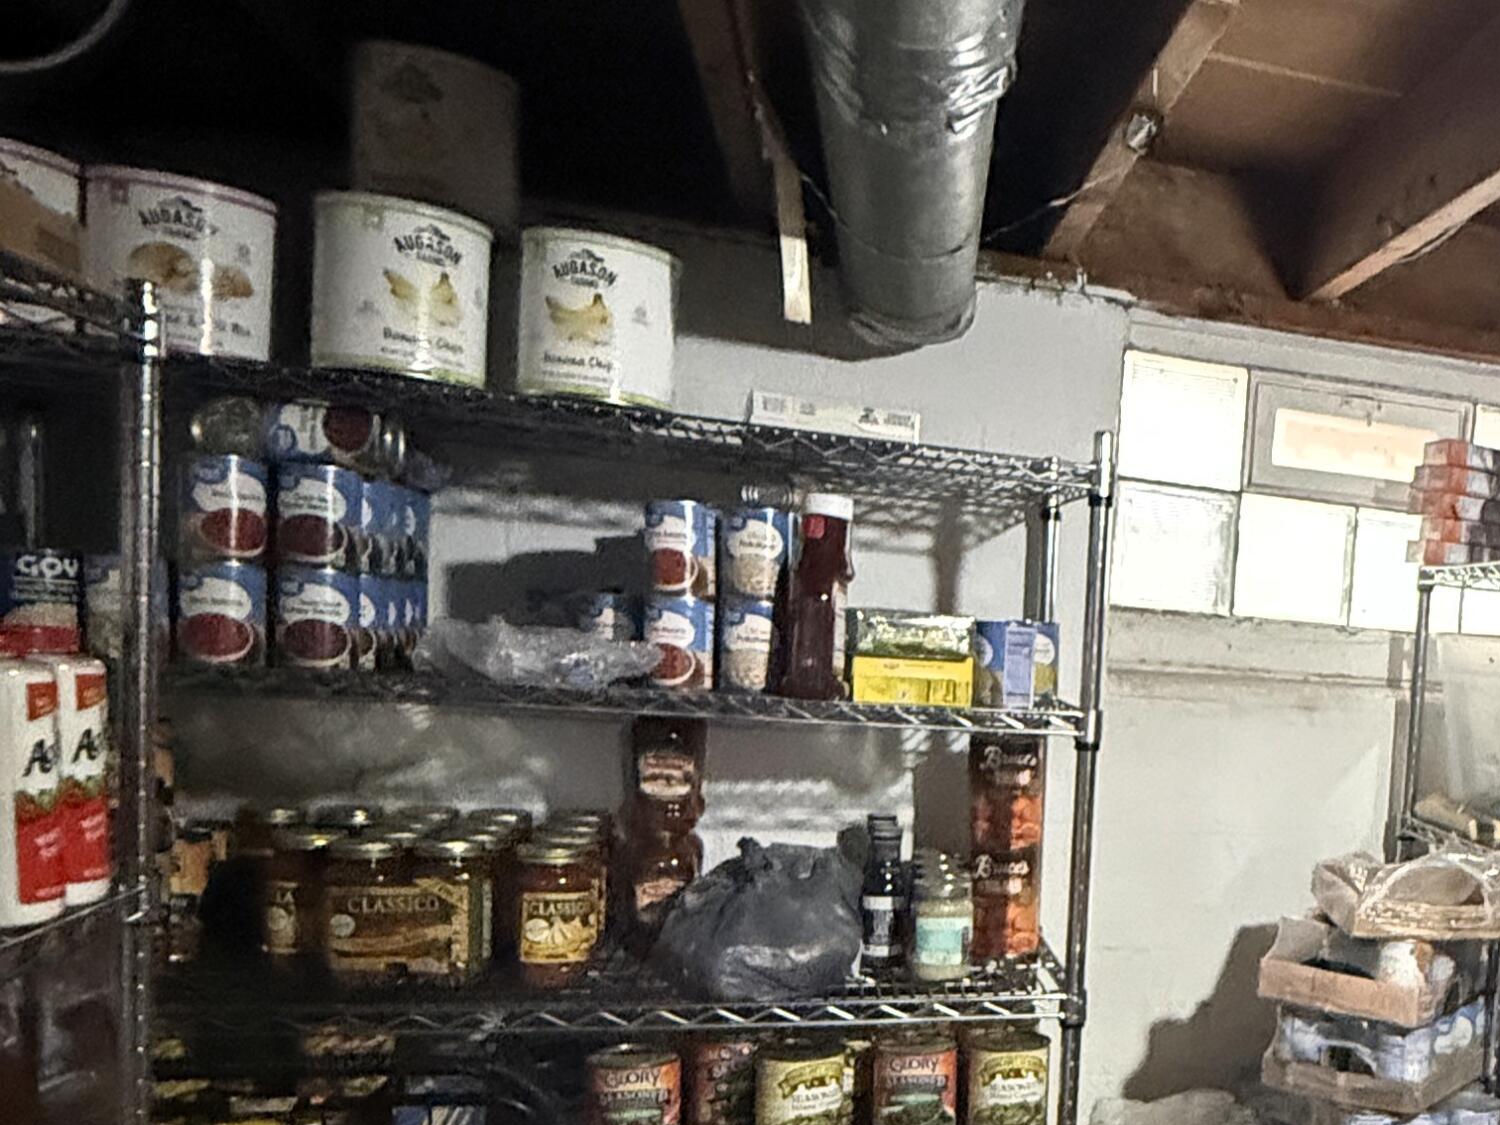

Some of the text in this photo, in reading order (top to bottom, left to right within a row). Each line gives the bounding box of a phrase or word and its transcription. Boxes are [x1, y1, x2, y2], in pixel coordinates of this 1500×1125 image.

[552, 260, 618, 287] AUGASON
[346, 896, 440, 914] CLASSICO
[890, 1057, 938, 1073] GLORY
[606, 1070, 661, 1088] GLORY
